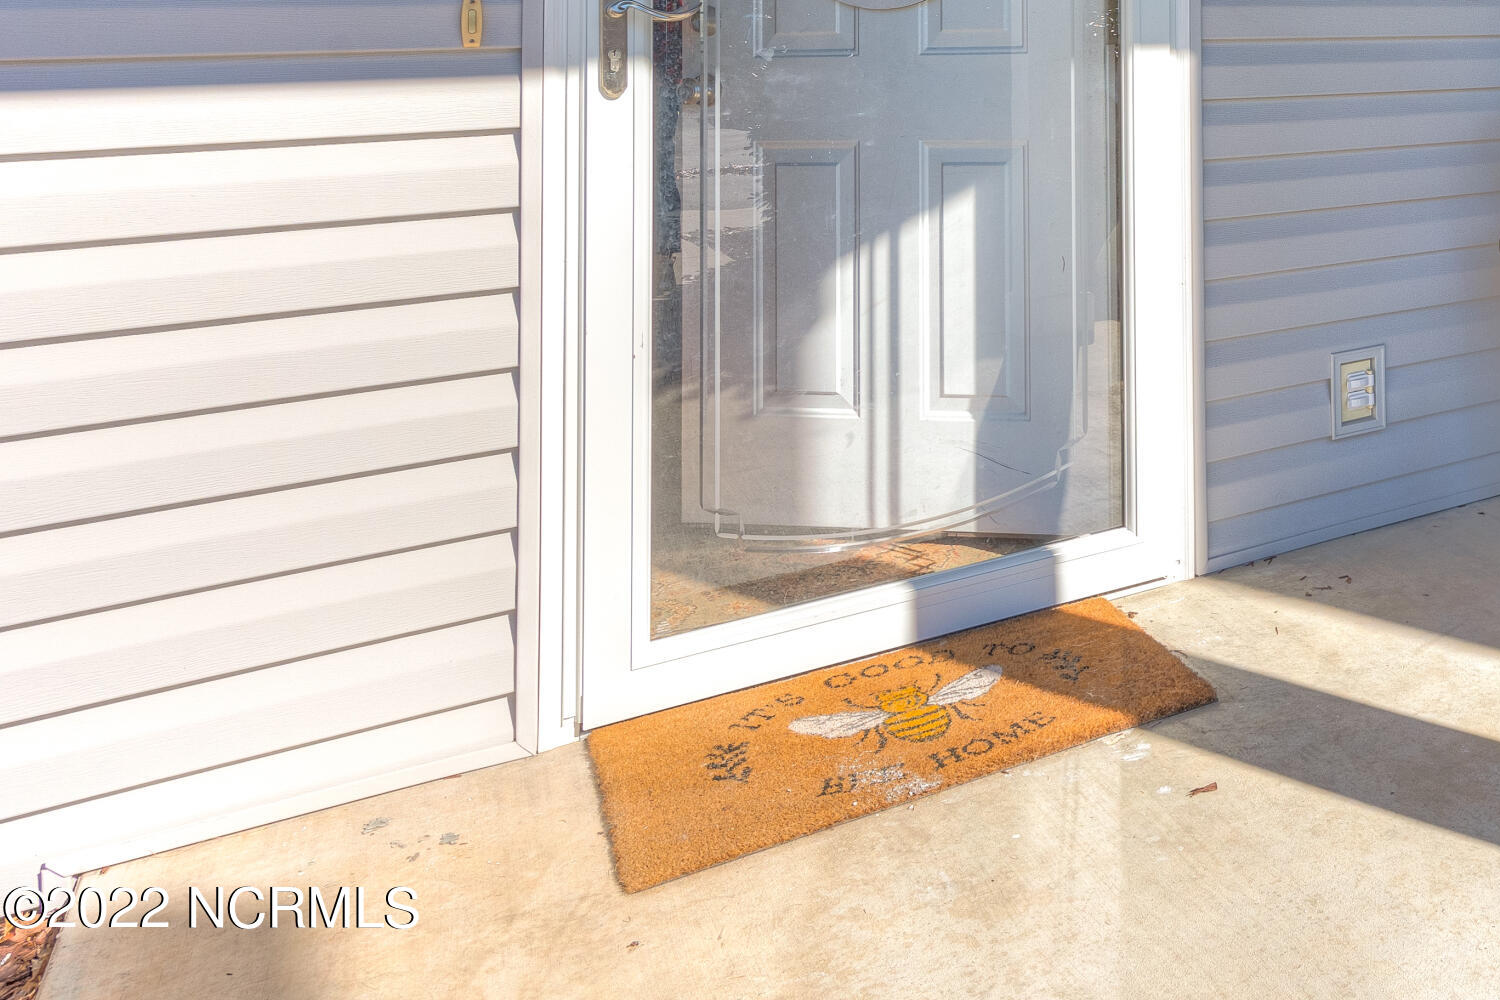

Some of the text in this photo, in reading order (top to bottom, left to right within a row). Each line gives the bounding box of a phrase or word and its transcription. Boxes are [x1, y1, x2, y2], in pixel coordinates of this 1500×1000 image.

[727, 642, 1036, 731] IT'S GOOD TO
[928, 711, 1056, 770] HOME
